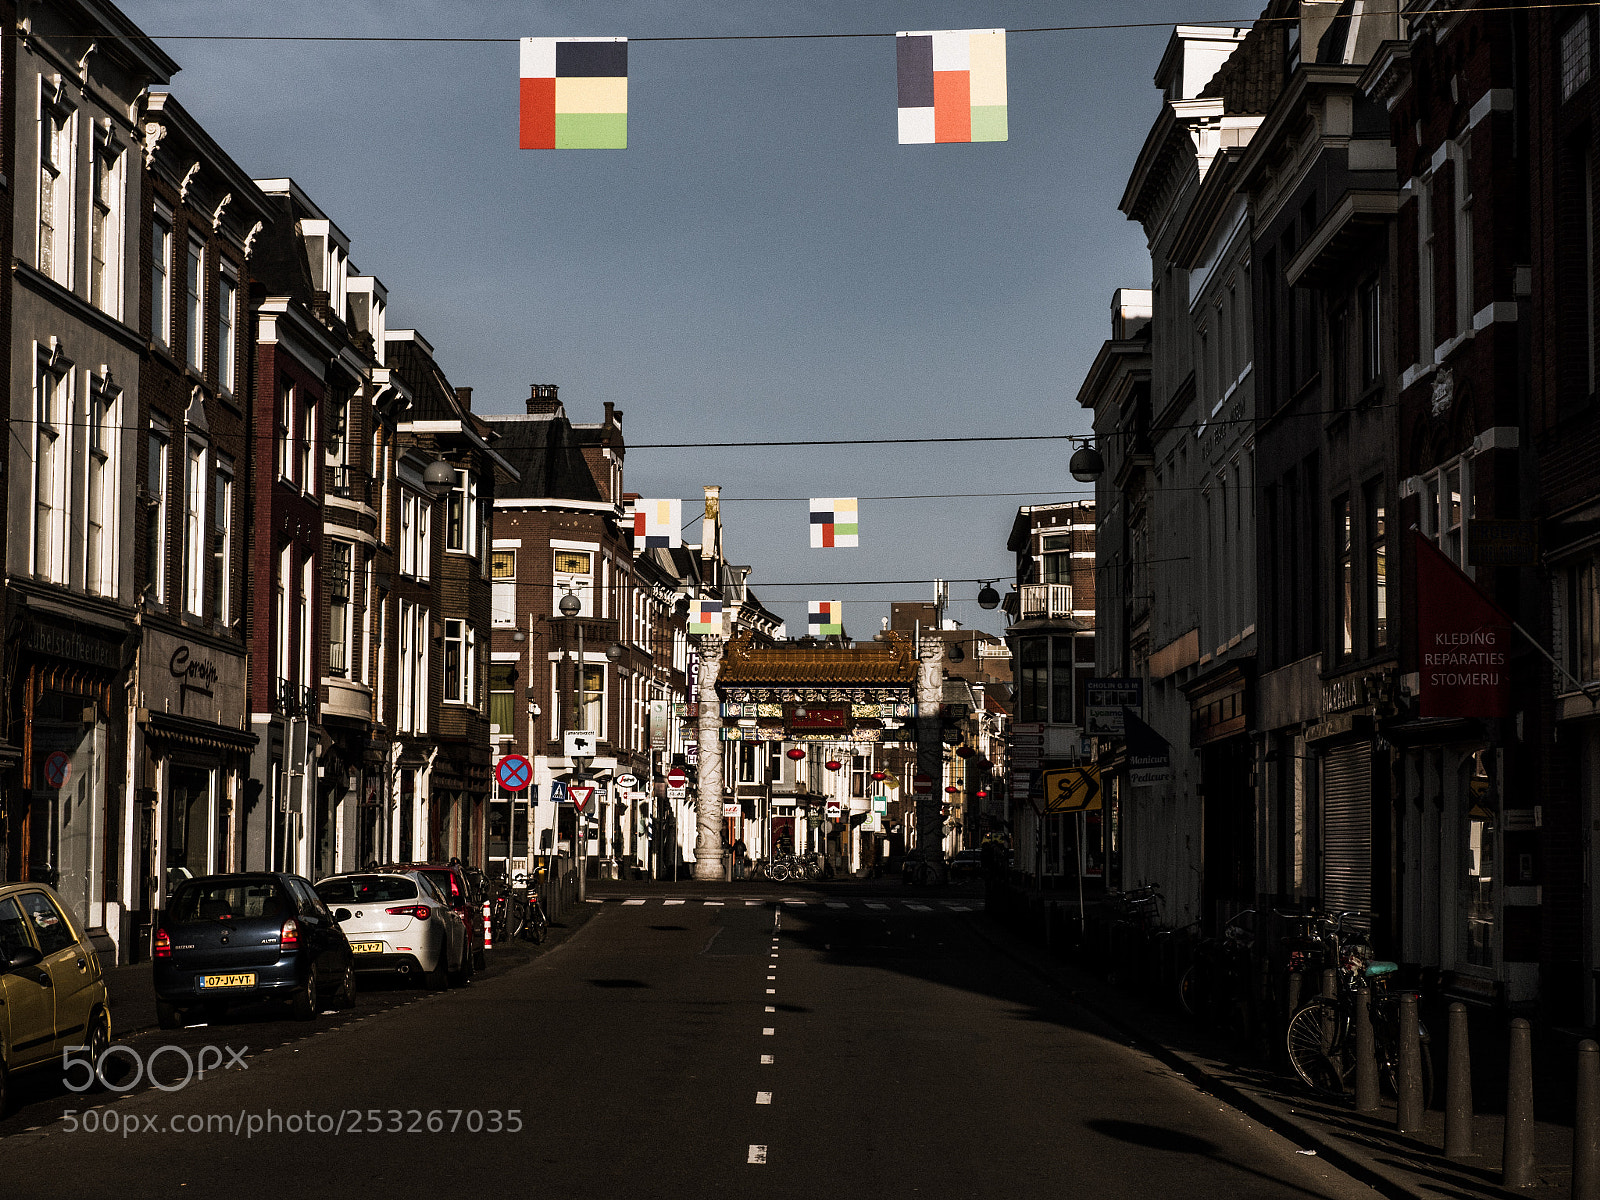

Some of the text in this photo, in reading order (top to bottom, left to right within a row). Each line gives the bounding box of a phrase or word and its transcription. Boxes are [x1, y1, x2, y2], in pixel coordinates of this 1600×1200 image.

[1435, 632, 1496, 645] KLEDING
[1424, 652, 1505, 665] REPARATIES
[691, 653, 700, 703] HOTEL
[1430, 673, 1499, 686] STOMERIJ
[1130, 755, 1168, 765] Manicure
[1131, 773, 1169, 783] Pedicure
[207, 975, 251, 986] 07-JV-VT
